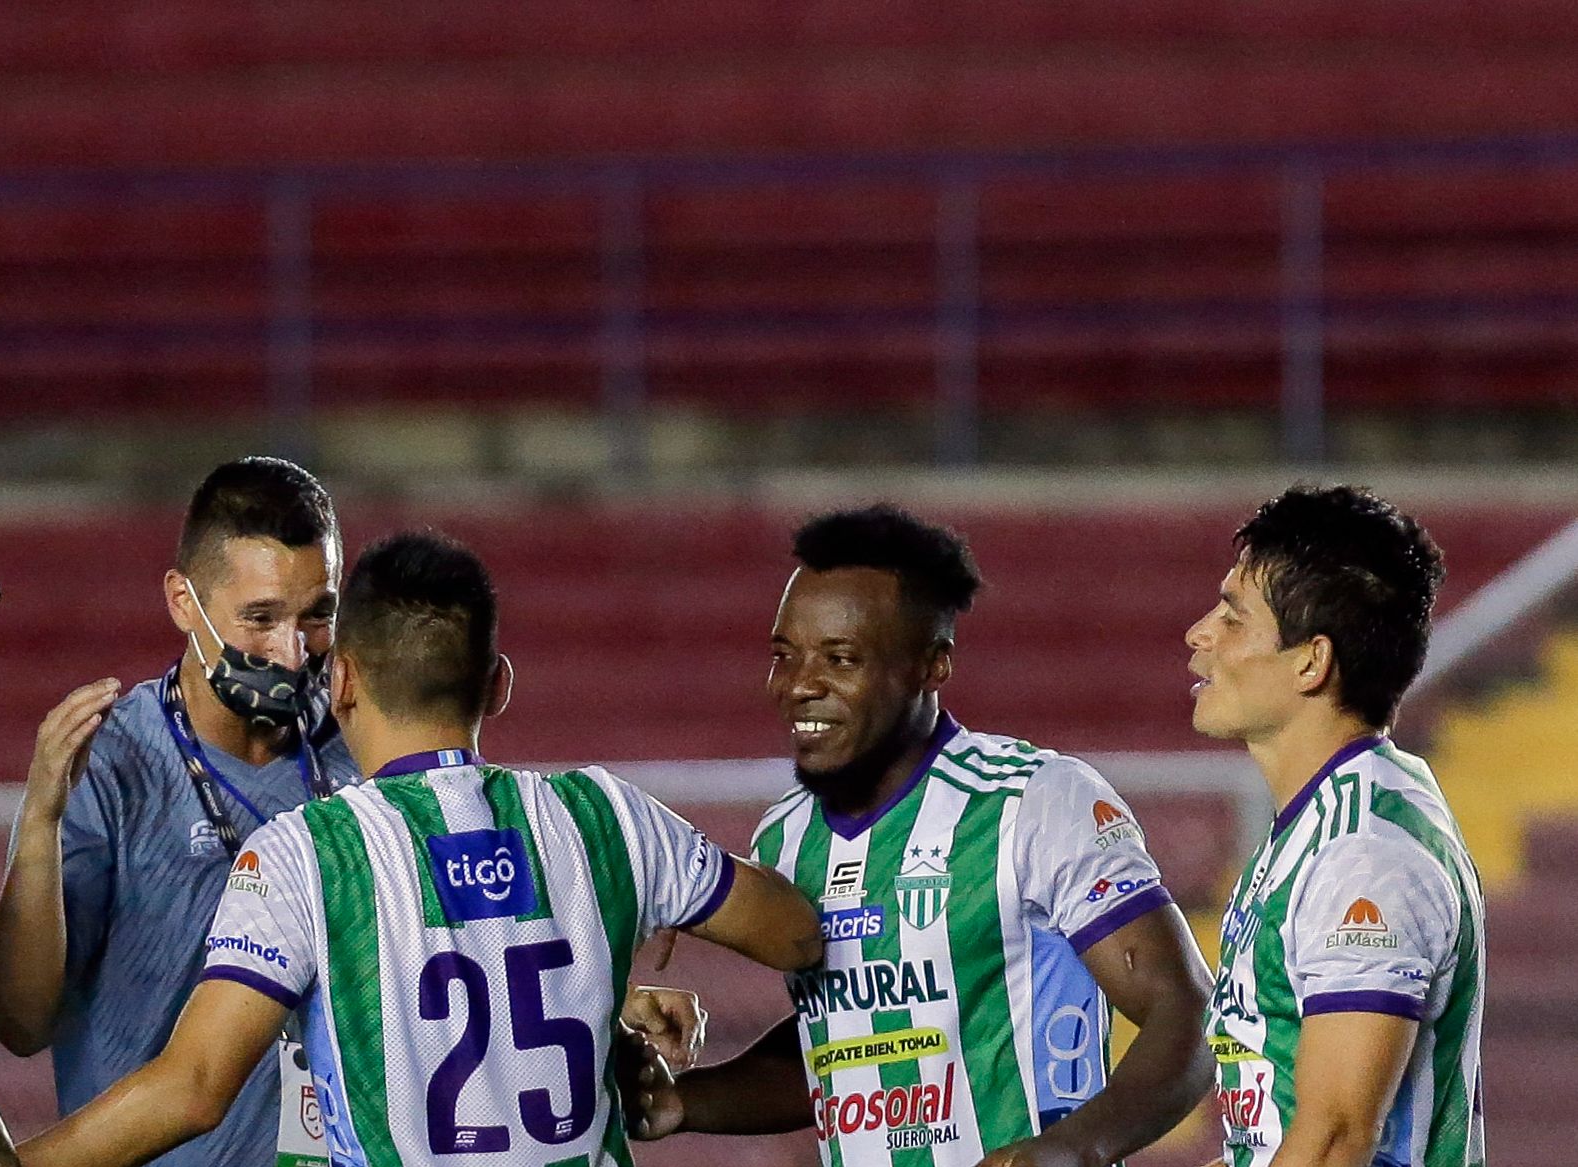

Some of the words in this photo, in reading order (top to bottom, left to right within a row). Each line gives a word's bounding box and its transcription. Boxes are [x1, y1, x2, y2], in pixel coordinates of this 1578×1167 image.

[446, 852, 515, 887] tigo
[1325, 935, 1340, 949] El
[1344, 932, 1398, 949] Mástil
[787, 958, 950, 1020] ANRURAL
[419, 938, 597, 1155] 25
